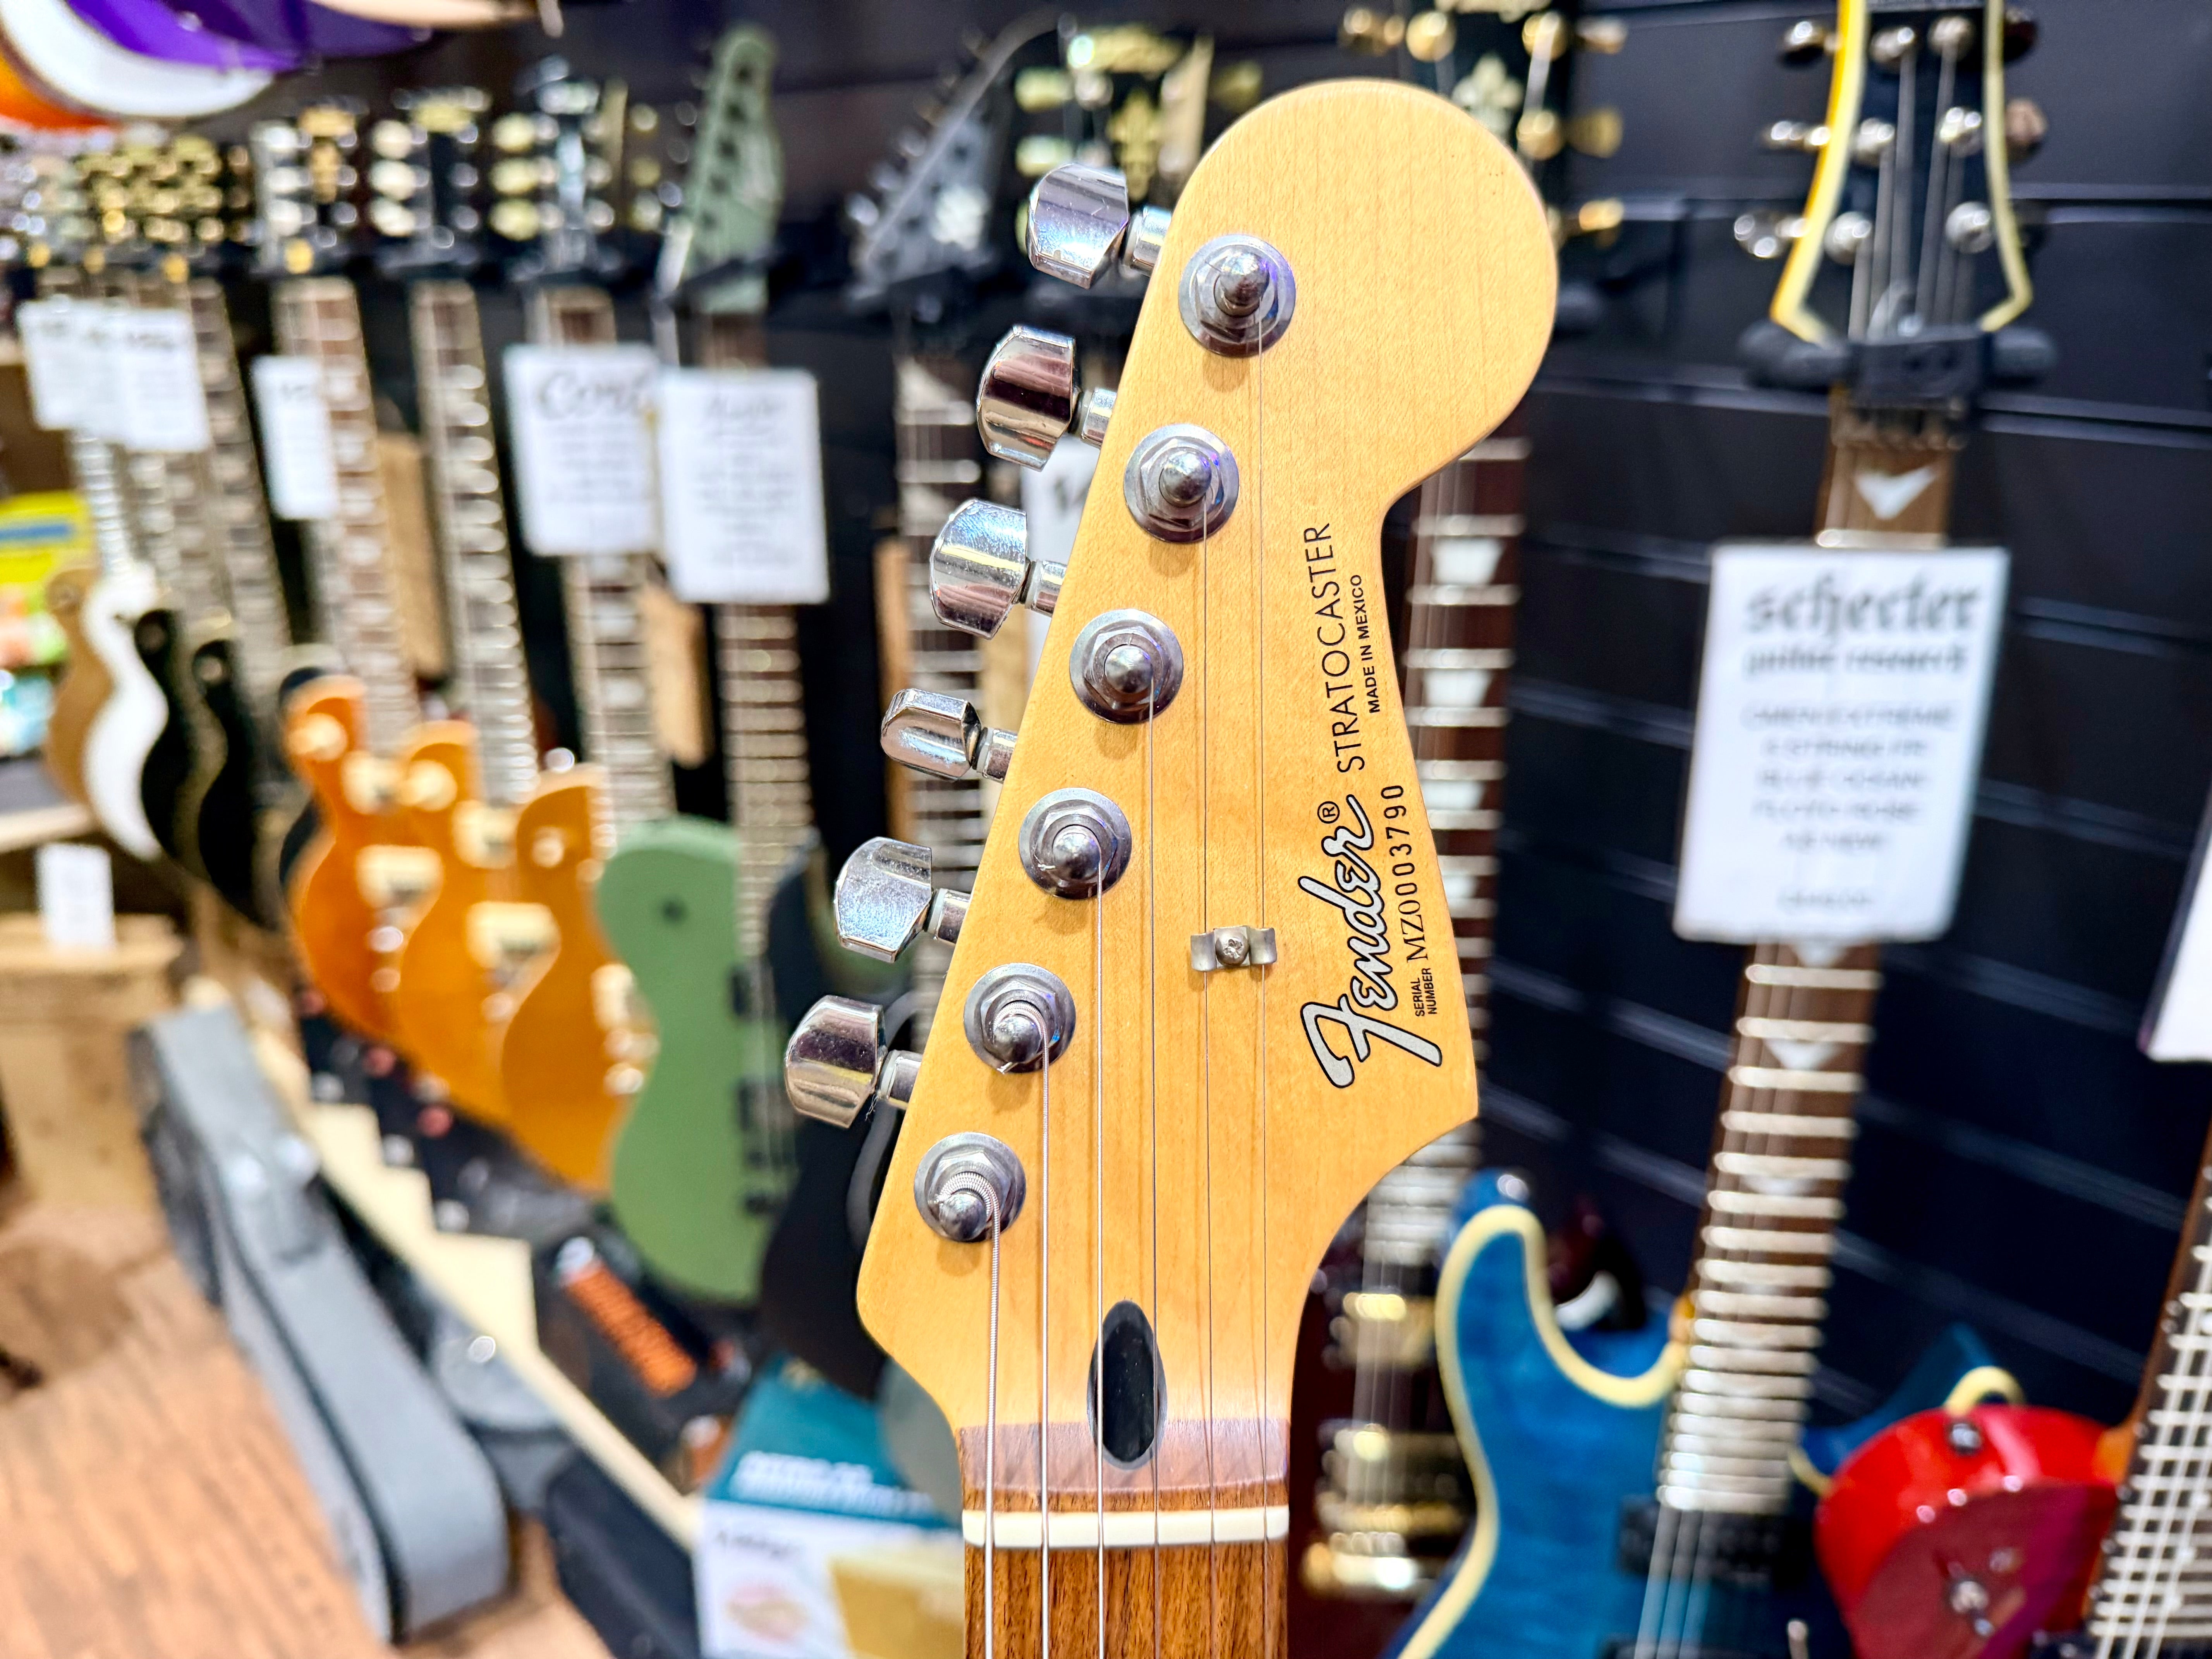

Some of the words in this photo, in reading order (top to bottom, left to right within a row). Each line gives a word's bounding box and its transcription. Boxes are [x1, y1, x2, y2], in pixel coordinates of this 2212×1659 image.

[1350, 574, 1370, 640] MEXICO
[1304, 523, 1365, 773] STRATOCASTER
[1359, 644, 1373, 661] IN
[1363, 665, 1380, 713] MADE
[1380, 785, 1429, 963] MZ0003790
[1415, 977, 1425, 1017] SERIAL
[1422, 967, 1438, 1015] NUMBER
